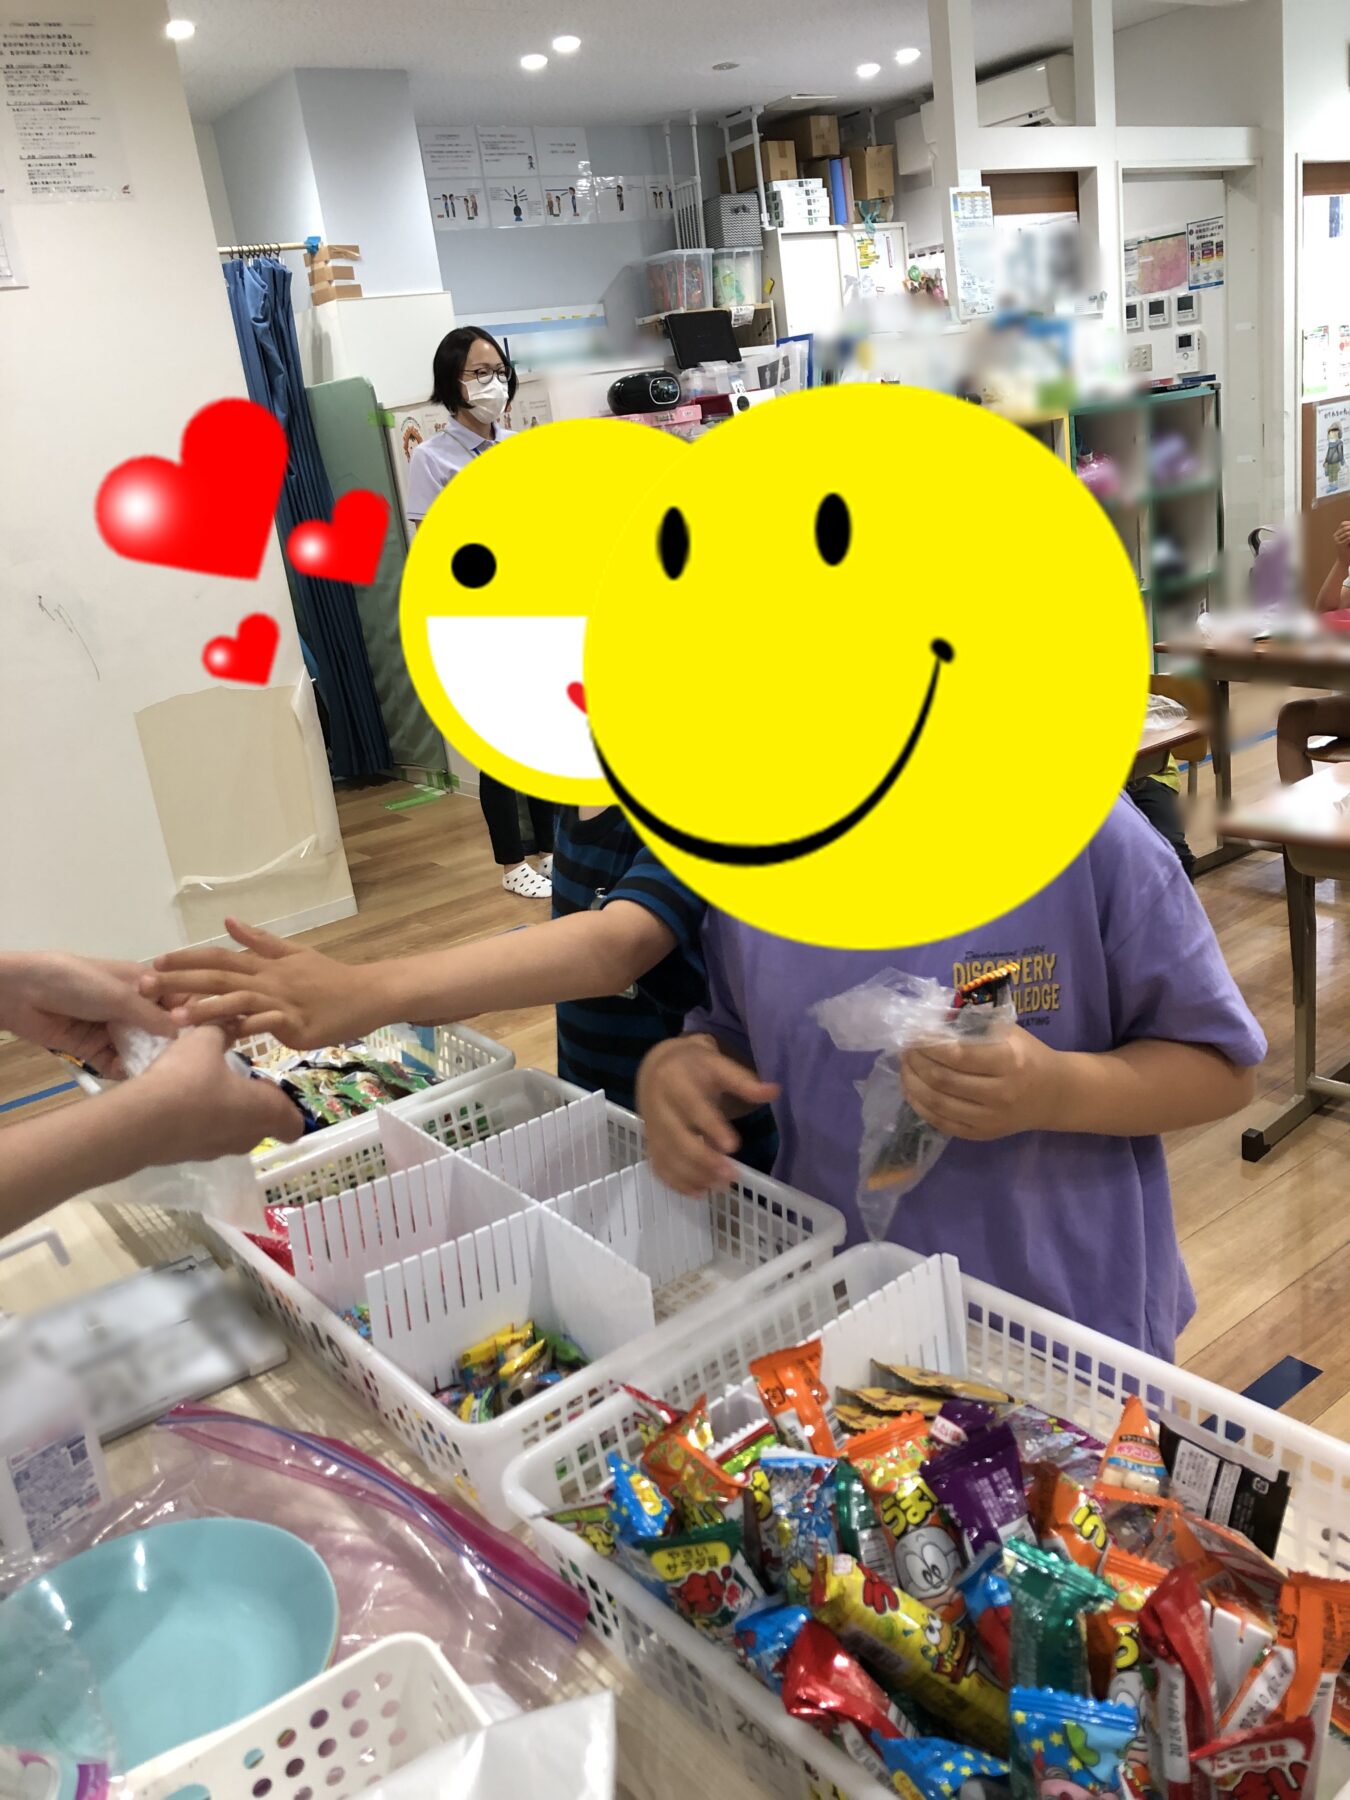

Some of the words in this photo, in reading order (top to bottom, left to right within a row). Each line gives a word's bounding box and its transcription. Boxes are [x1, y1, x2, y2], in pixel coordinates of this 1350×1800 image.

[953, 954, 1056, 988] DISCVERY
[667, 1546, 709, 1560] やさい
[666, 1555, 719, 1576] サラダ味
